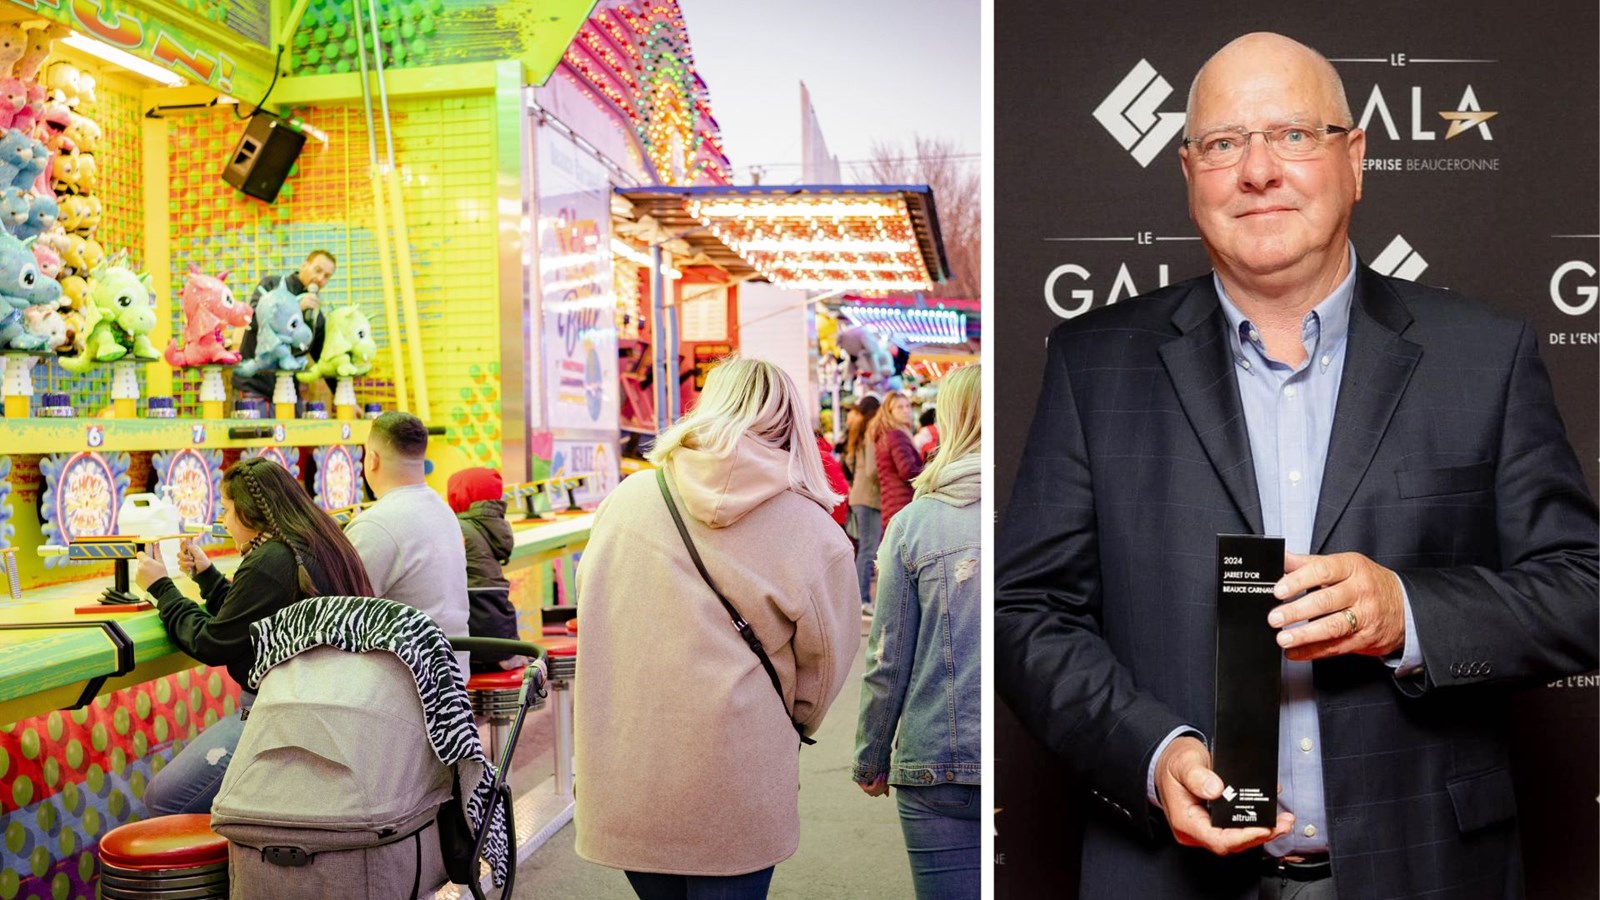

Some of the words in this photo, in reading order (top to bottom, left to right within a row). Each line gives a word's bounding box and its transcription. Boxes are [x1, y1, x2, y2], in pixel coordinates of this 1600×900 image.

[1390, 53, 1406, 66] LE
[1357, 83, 1499, 141] ALA
[1362, 158, 1403, 171] EPRISE
[1406, 158, 1500, 171] BEAUCERONNE
[1138, 231, 1152, 244] LE
[1550, 260, 1599, 316] G
[1549, 332, 1566, 345] DE
[1570, 332, 1600, 345] L'EN
[88, 426, 101, 447] 6
[193, 424, 204, 443] 7
[274, 424, 285, 442] 8
[341, 423, 351, 440] 9
[1223, 556, 1243, 565] 2024
[1223, 571, 1243, 579] JARRET
[1244, 571, 1260, 579] D'OR
[1247, 586, 1275, 594] CARNAV
[1567, 675, 1600, 688] L'ENT
[1231, 814, 1257, 822] altrum
